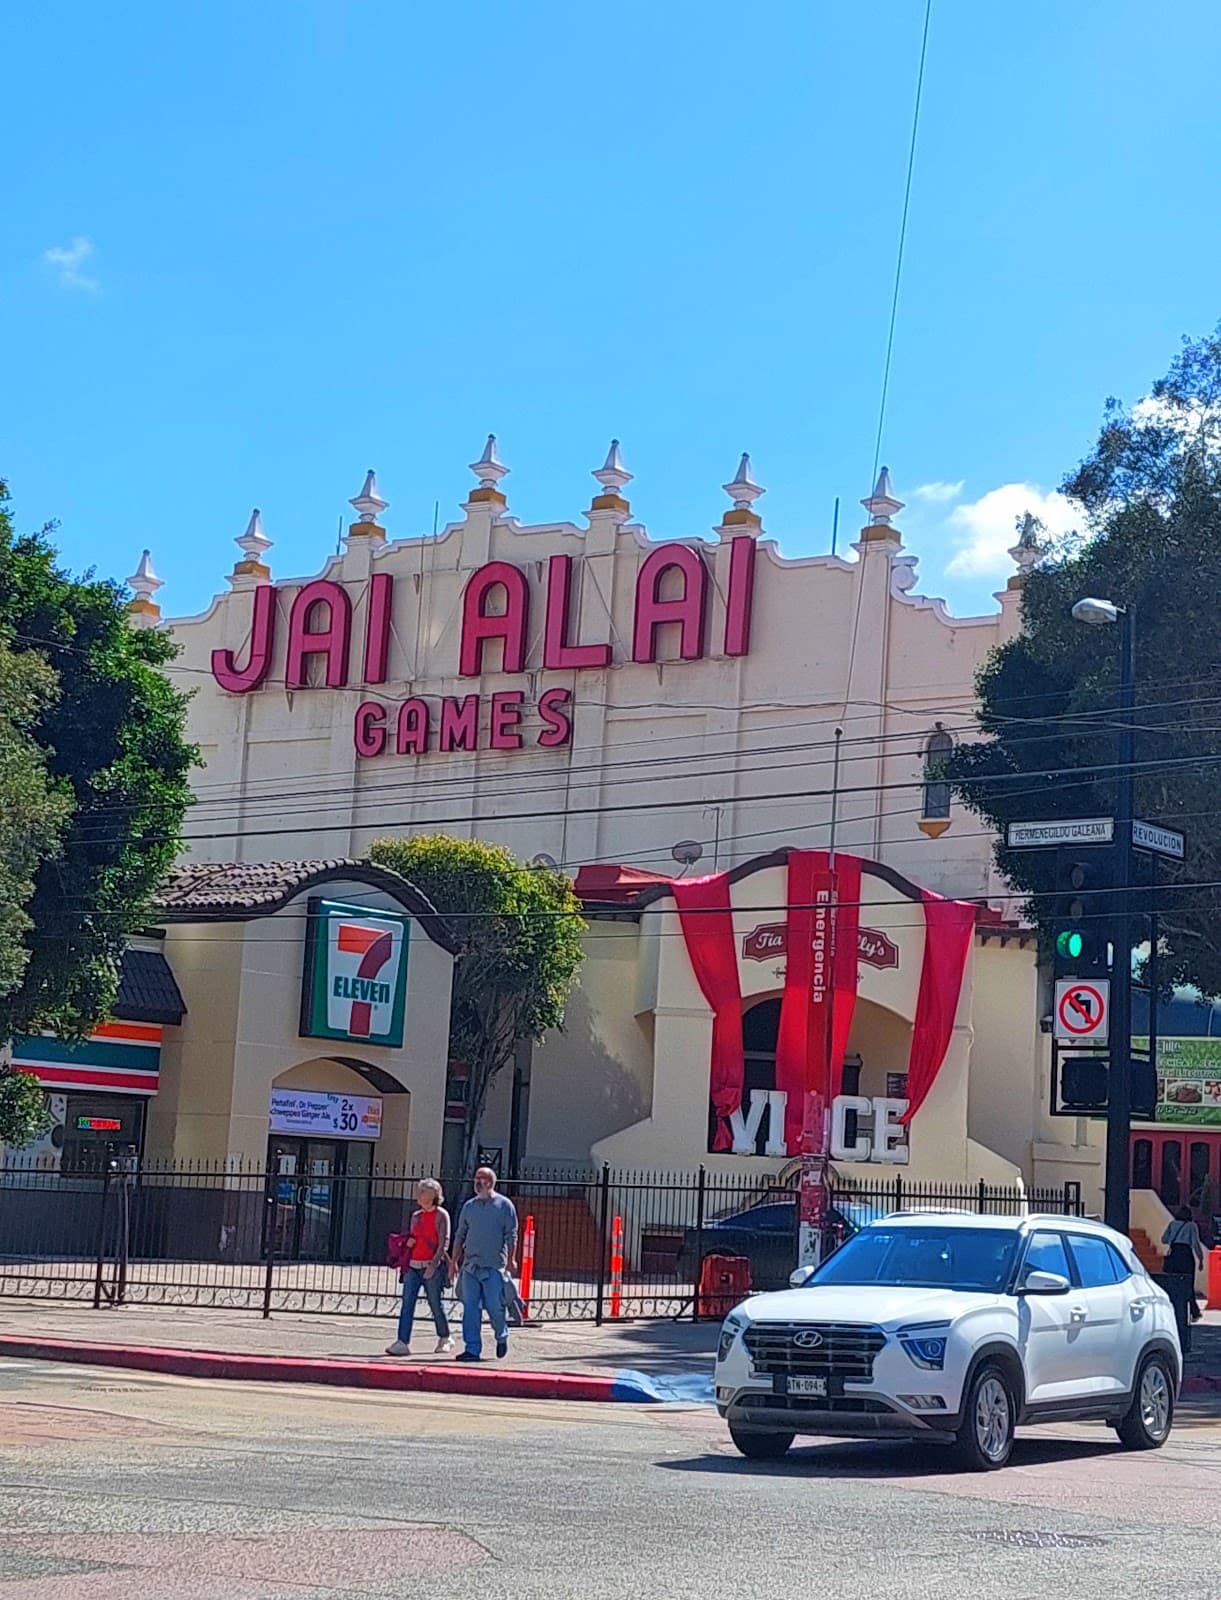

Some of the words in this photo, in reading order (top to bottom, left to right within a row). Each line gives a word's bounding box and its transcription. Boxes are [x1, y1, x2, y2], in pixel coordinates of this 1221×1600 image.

[210, 572, 394, 694] JAI
[458, 536, 757, 677] ALAI
[354, 688, 571, 758] GAMES
[1071, 823, 1106, 836] GALEANA
[337, 924, 393, 1036] 7
